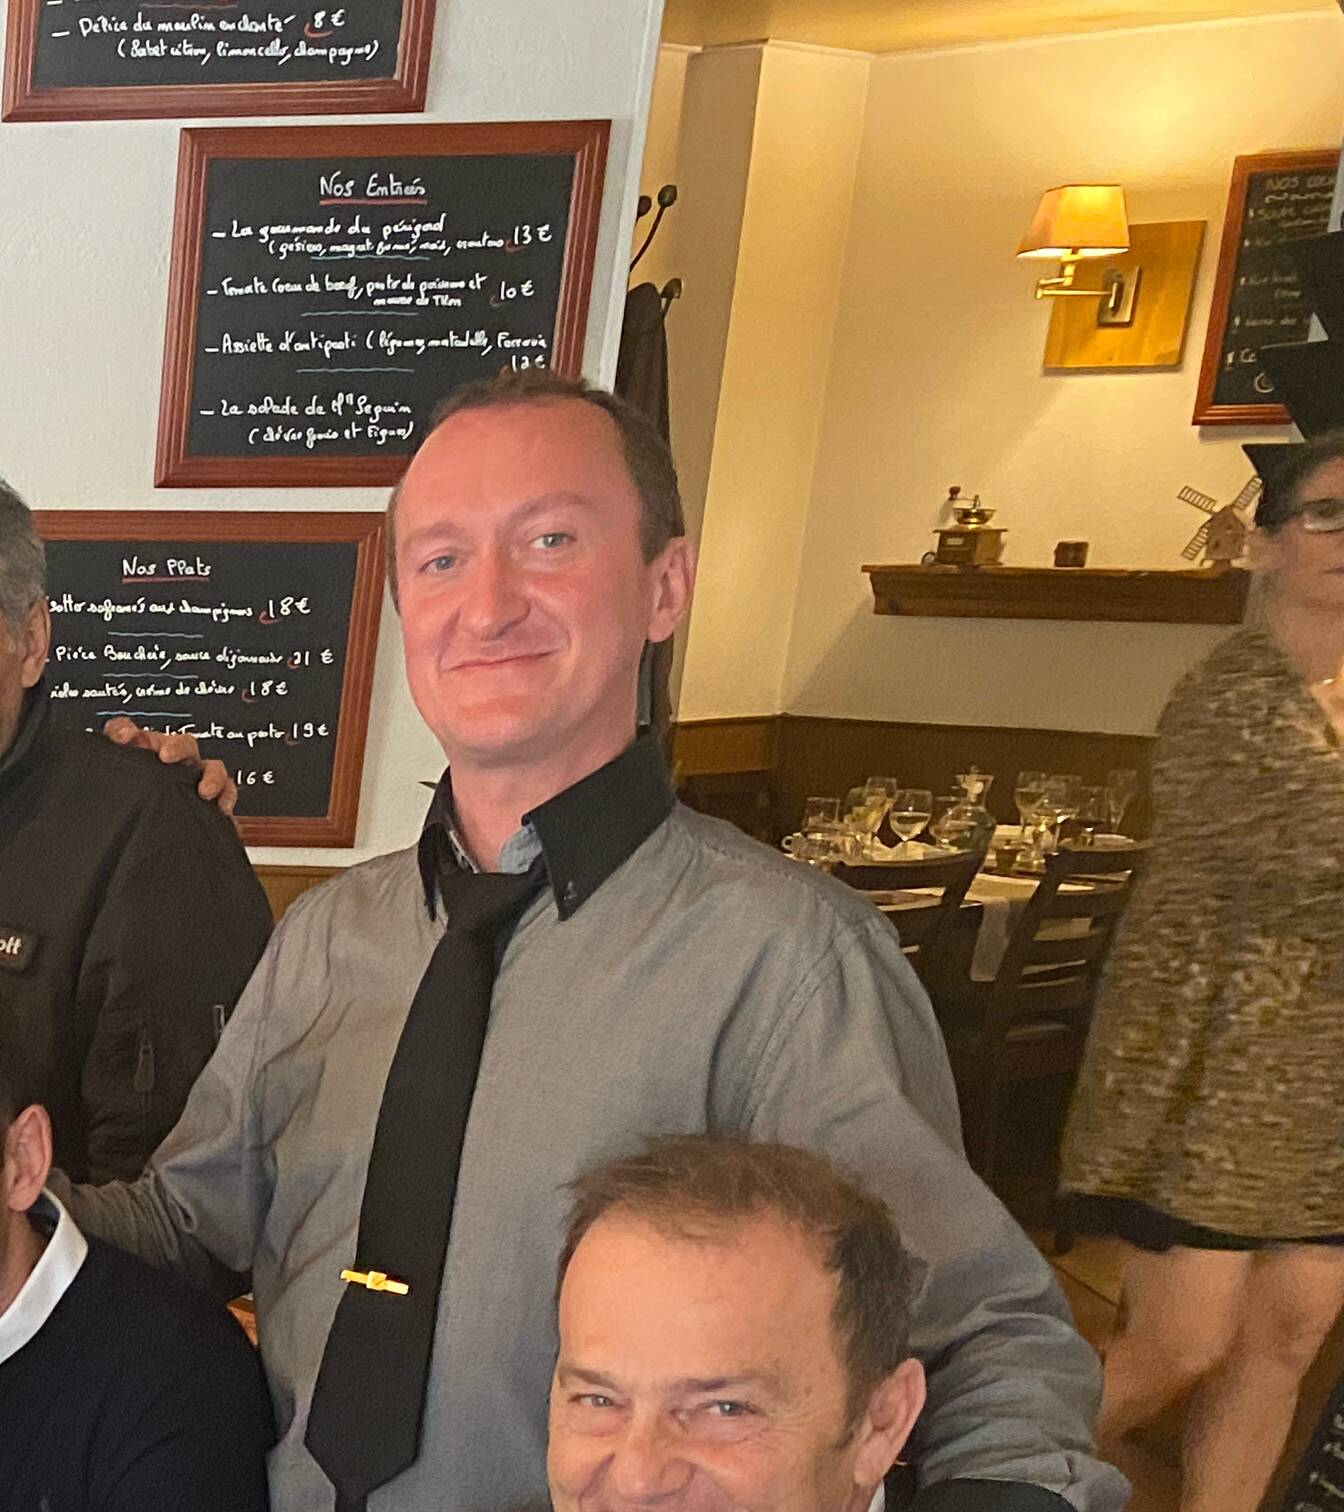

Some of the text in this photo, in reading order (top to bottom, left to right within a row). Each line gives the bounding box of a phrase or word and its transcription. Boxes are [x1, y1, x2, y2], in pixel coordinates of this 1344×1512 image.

[133, 12, 153, 32] du
[319, 171, 355, 197] Nos
[231, 220, 253, 238] La
[347, 214, 372, 234] du
[305, 274, 321, 293] de
[468, 272, 489, 290] et
[222, 332, 274, 354] Assiette
[247, 395, 300, 416] salade
[304, 394, 327, 416] de
[343, 421, 363, 440] et
[121, 555, 157, 576] Nos
